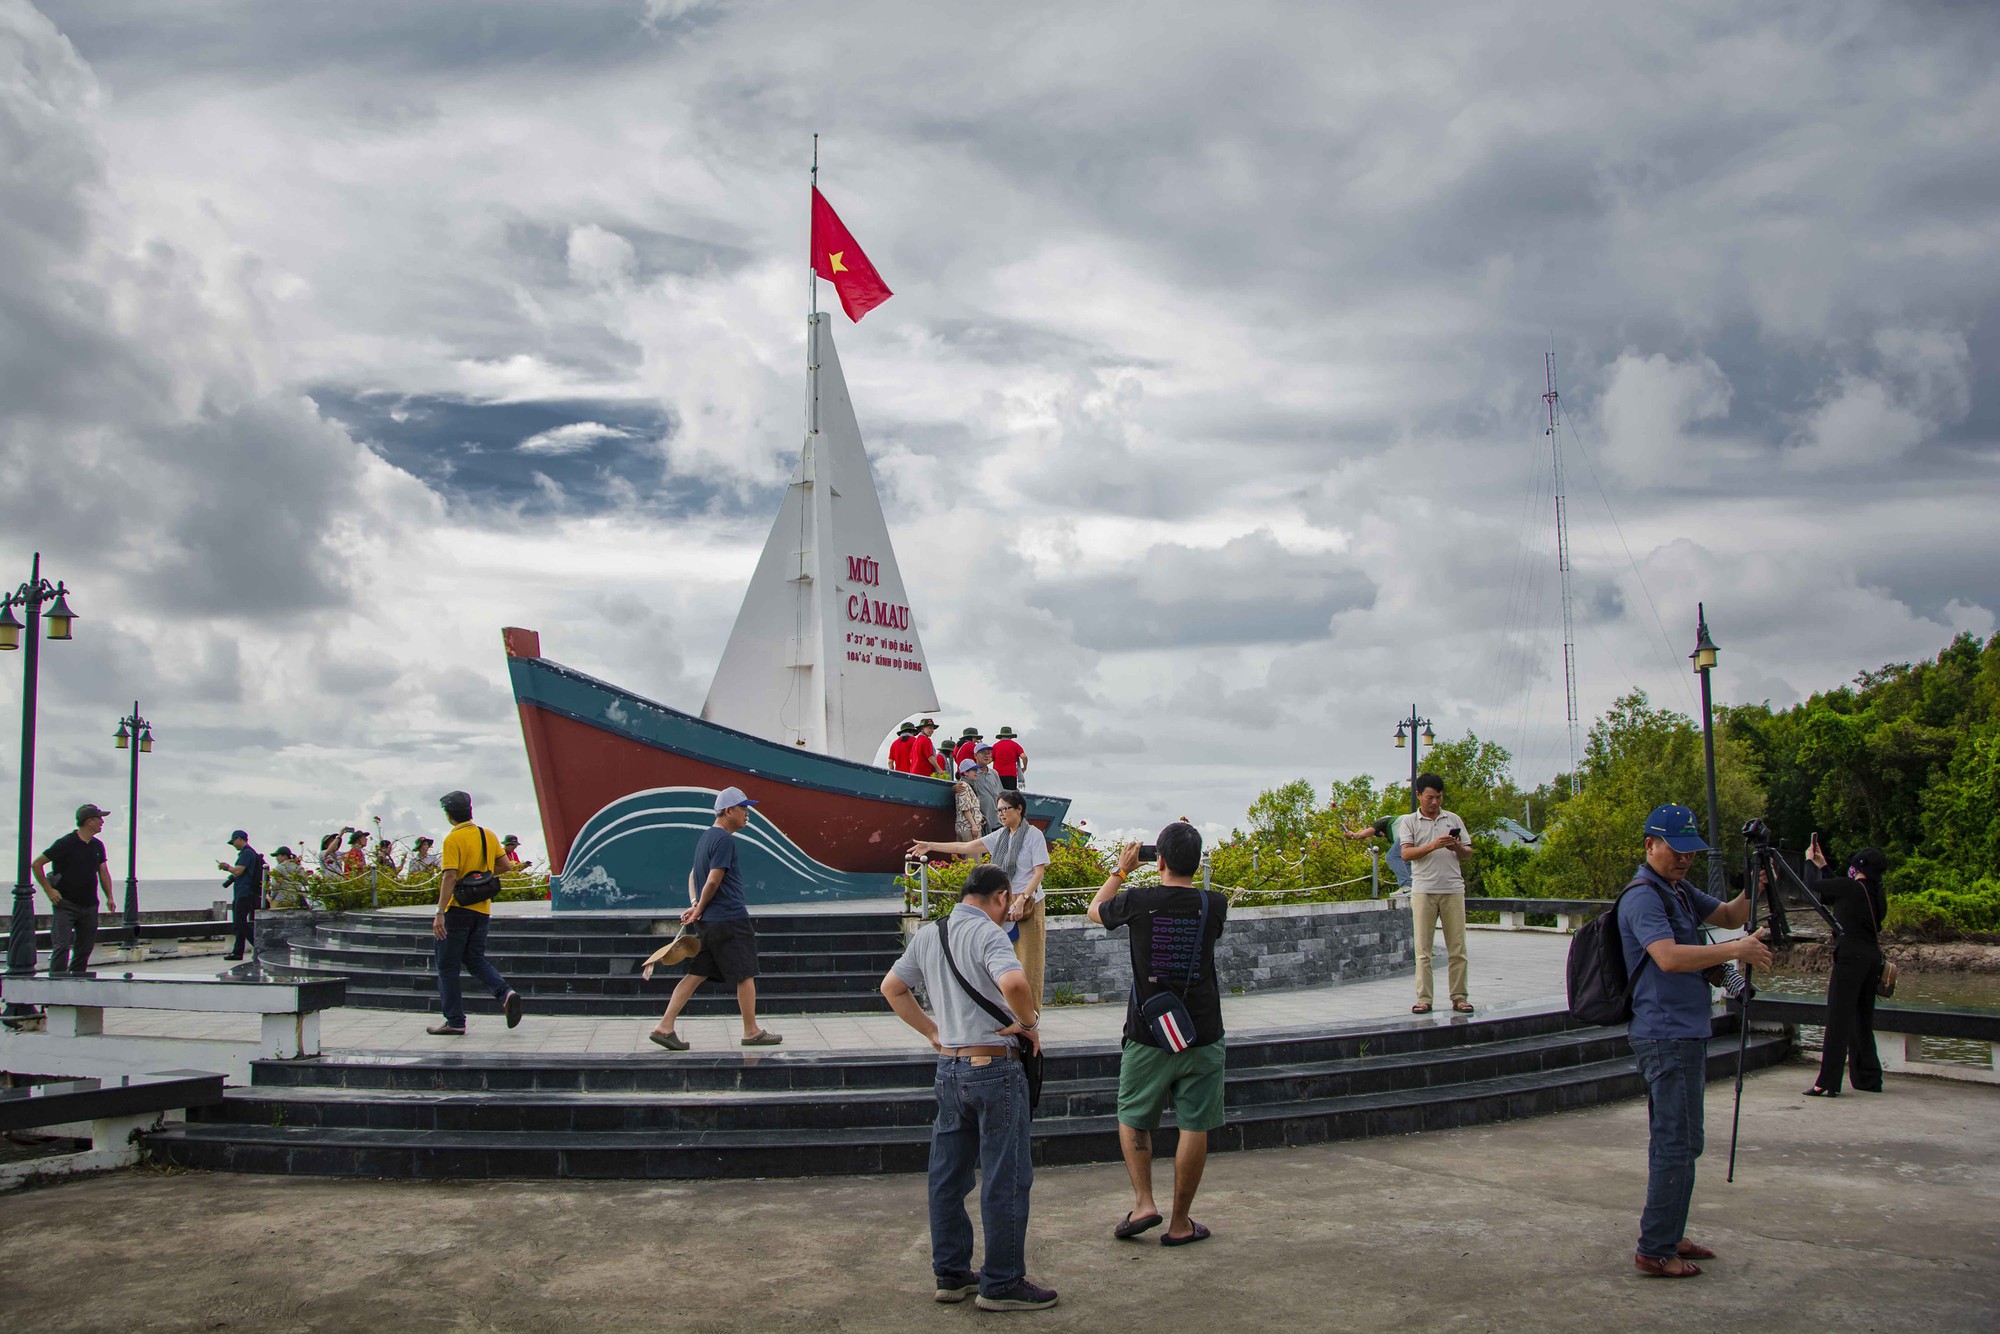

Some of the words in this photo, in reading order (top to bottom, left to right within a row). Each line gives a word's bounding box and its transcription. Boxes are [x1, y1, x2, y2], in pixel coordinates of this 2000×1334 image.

[848, 555, 879, 586] MŨI
[848, 591, 872, 624] CÀ
[874, 600, 909, 631] MAU
[889, 639, 898, 653] ĐỘ
[893, 657, 903, 671] ĐỘ
